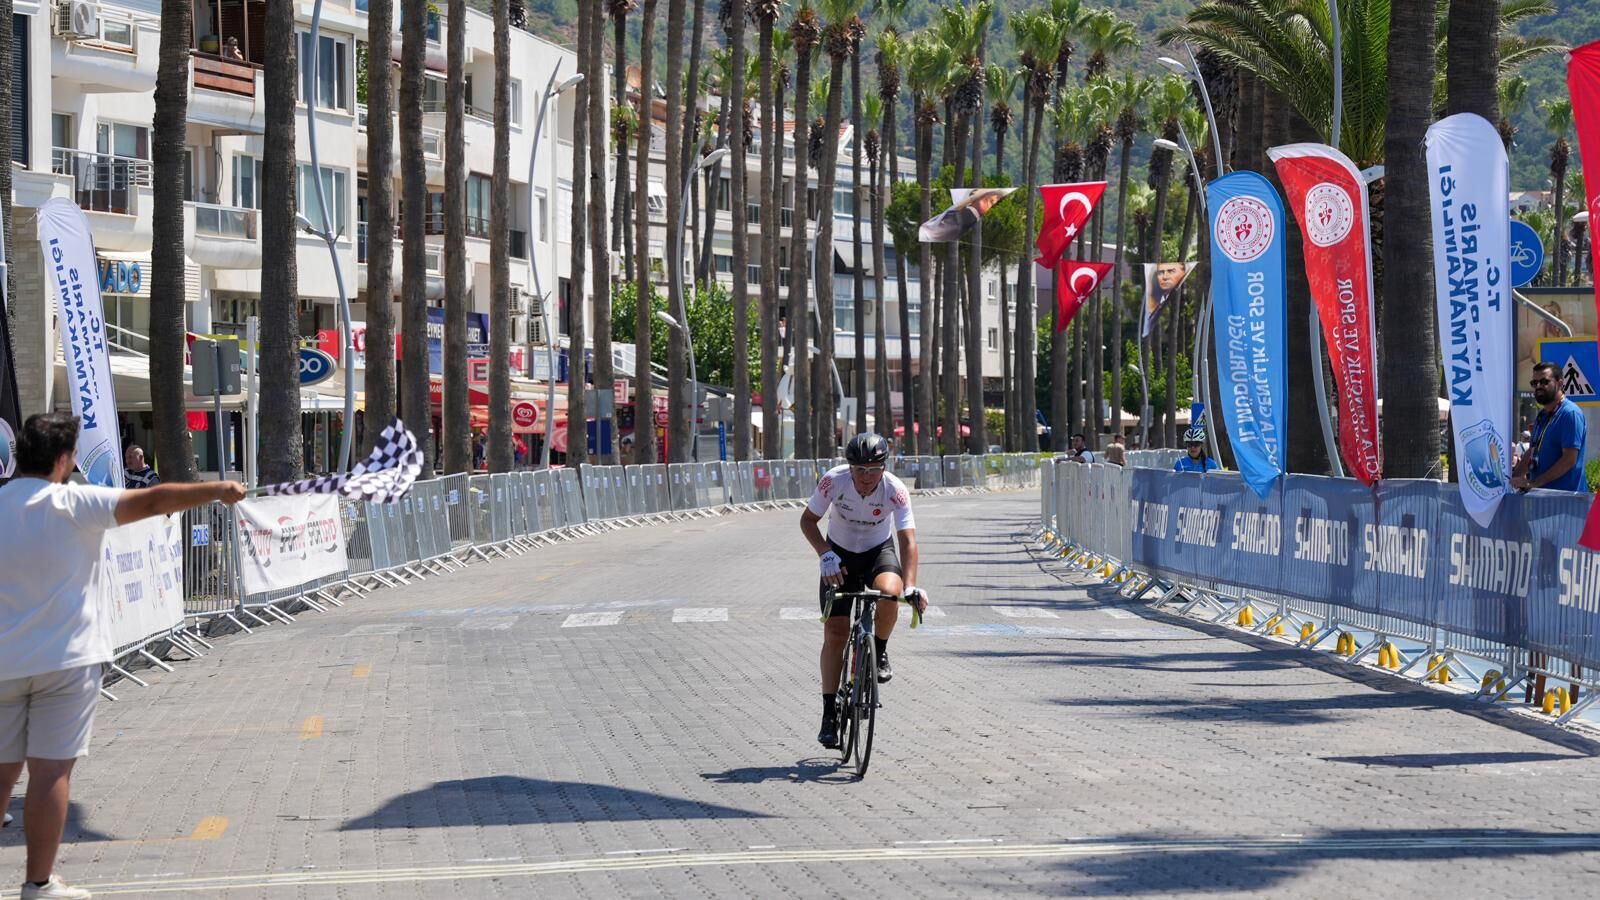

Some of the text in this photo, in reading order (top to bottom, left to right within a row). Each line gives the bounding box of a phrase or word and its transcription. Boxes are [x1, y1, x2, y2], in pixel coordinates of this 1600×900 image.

[1175, 506, 1221, 548] SHIMANO
[1231, 511, 1280, 556] SHIMANO
[1294, 516, 1348, 566] SHIMANO
[1364, 523, 1428, 579] SHIMANO
[1449, 533, 1533, 598] SHIMANO
